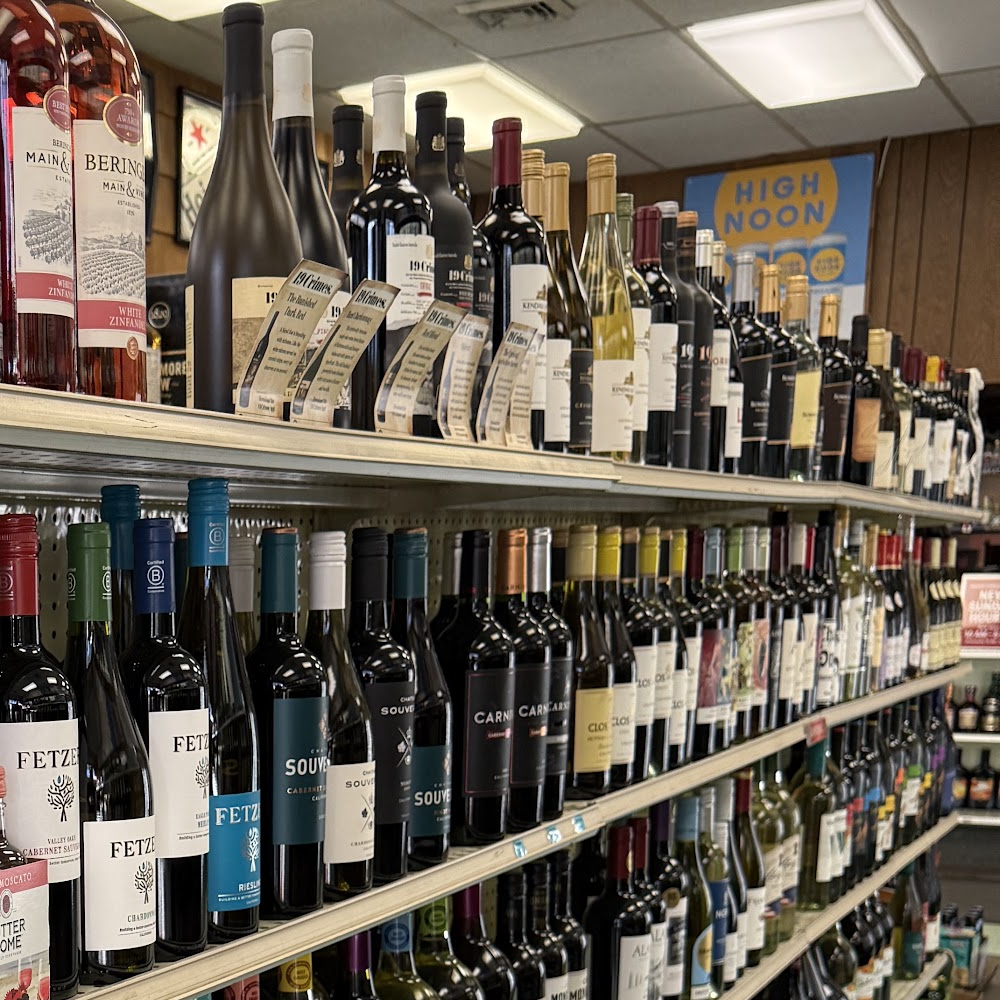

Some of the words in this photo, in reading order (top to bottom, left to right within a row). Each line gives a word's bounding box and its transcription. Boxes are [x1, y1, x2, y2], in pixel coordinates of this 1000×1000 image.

[26, 151, 59, 166] MAIN
[60, 151, 71, 176] &
[102, 181, 125, 192] MAIN
[126, 181, 136, 199] &
[735, 171, 819, 205] HIGH
[724, 201, 824, 235] NOON
[409, 260, 419, 272] 19
[292, 271, 303, 285] 19
[448, 269, 459, 281] 19
[118, 305, 142, 319] WHITE
[681, 344, 695, 361] 19
[588, 722, 608, 734] CLOS
[285, 756, 327, 776] SOUVE
[286, 784, 324, 795] CABERNET
[47, 836, 66, 845] VALLEY
[22, 846, 62, 857] CABERNET
[0, 872, 32, 889] MOSCATO
